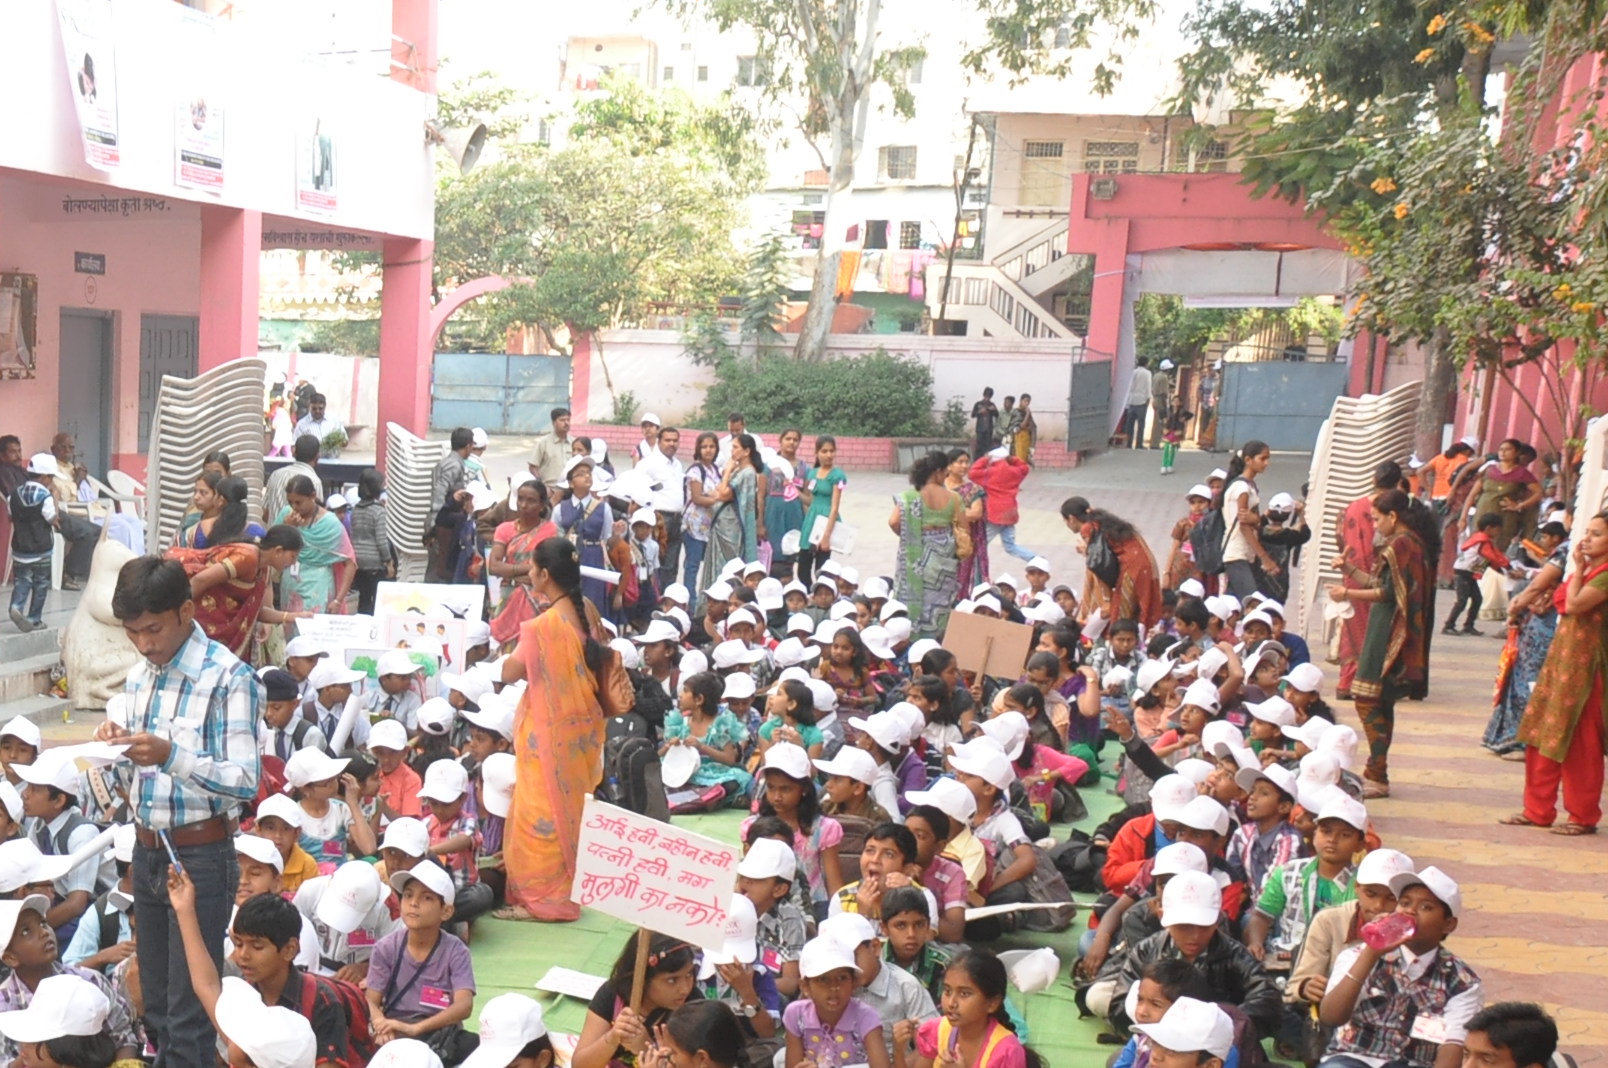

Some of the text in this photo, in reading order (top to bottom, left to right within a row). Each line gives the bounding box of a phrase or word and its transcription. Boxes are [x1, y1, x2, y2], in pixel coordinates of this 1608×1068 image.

[587, 841, 634, 869] पत्नी
[580, 871, 641, 907] मुलगी
[637, 886, 670, 912] का
